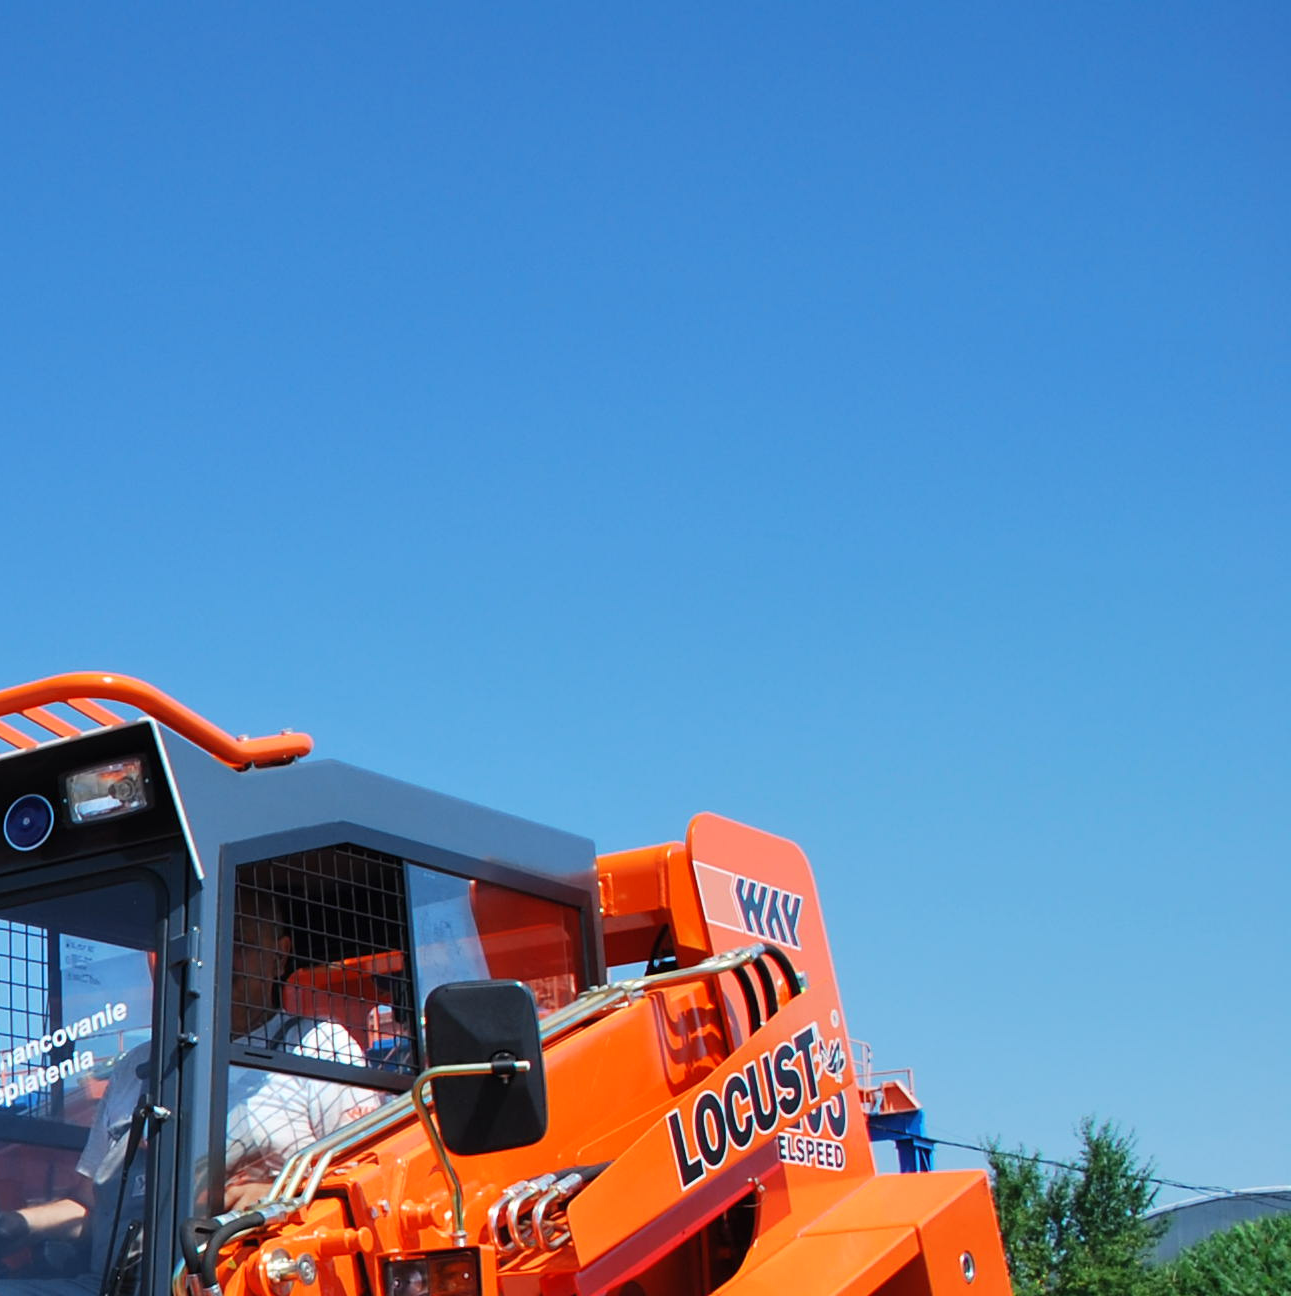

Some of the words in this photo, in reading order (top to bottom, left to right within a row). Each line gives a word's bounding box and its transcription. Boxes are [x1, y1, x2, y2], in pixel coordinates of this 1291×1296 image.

[734, 876, 803, 949] WAY
[668, 1023, 819, 1190] LOCUST
[777, 1134, 845, 1170] ELSPEED
